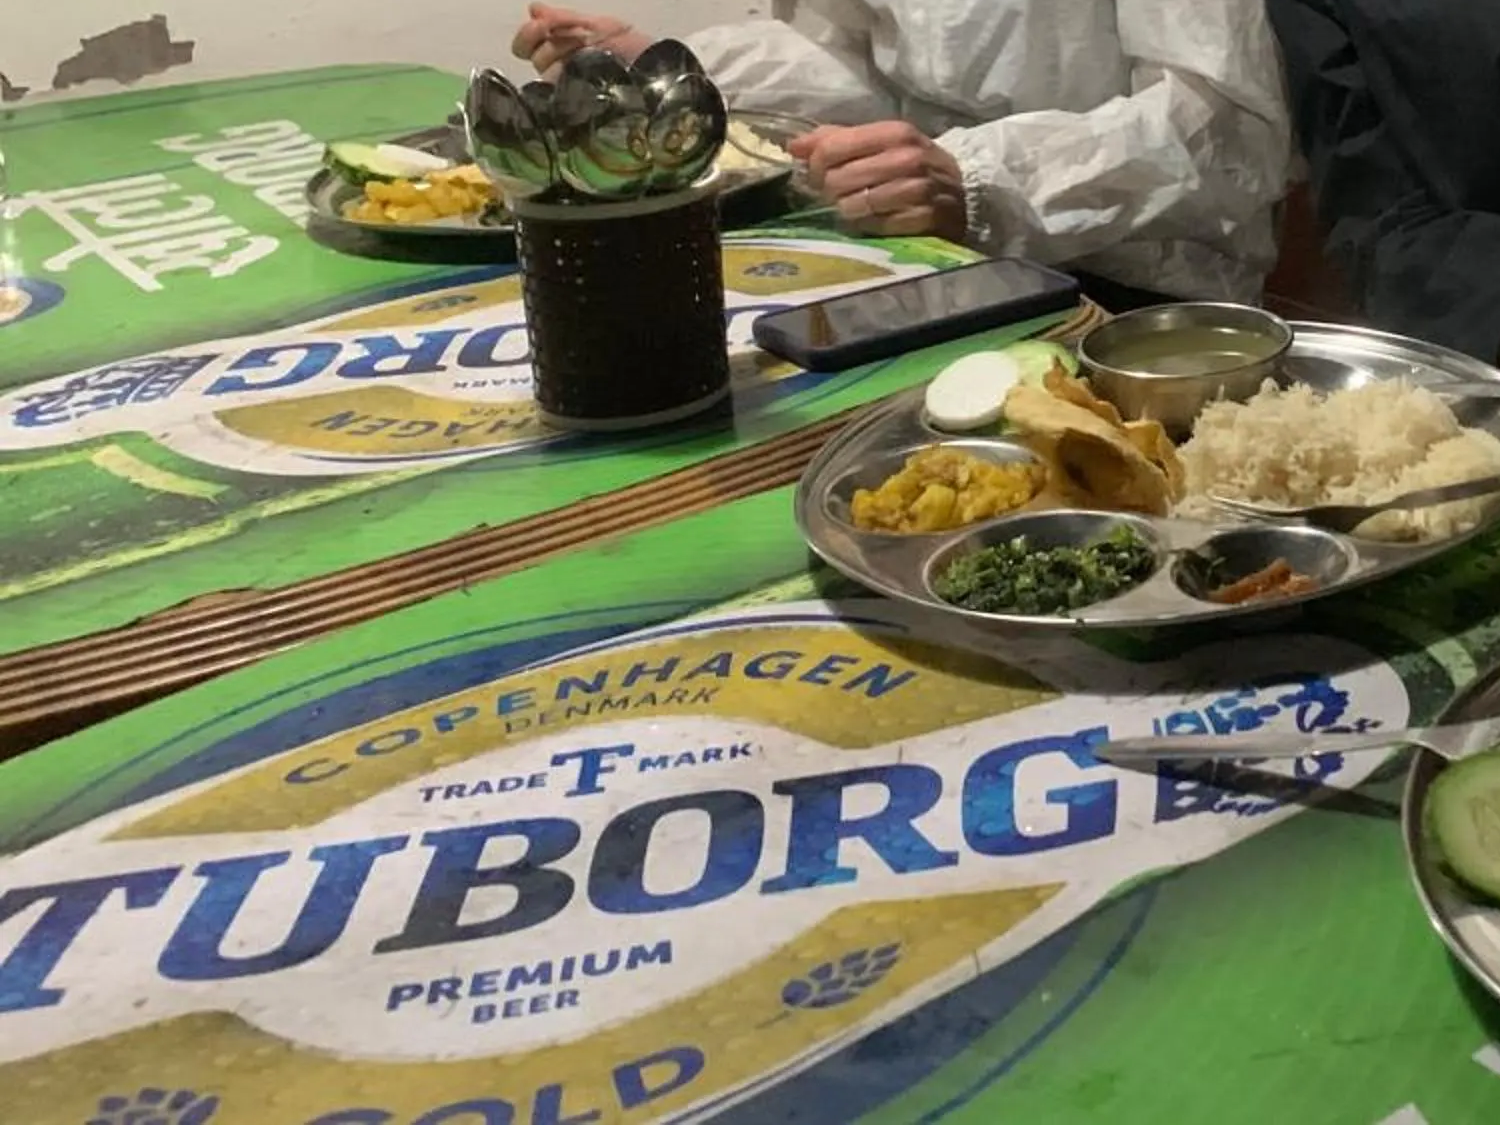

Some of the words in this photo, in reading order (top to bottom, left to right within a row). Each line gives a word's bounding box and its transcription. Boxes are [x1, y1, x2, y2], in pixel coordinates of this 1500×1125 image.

[309, 410, 534, 438] HAGEN
[284, 649, 917, 786] COPENHAGEN
[505, 685, 722, 735] DENMARK
[419, 771, 548, 803] TRADE
[637, 741, 754, 773] MARK
[0, 726, 1118, 1012] TUBORG
[386, 940, 674, 1012] PREMIUM
[471, 988, 582, 1025] BEER
